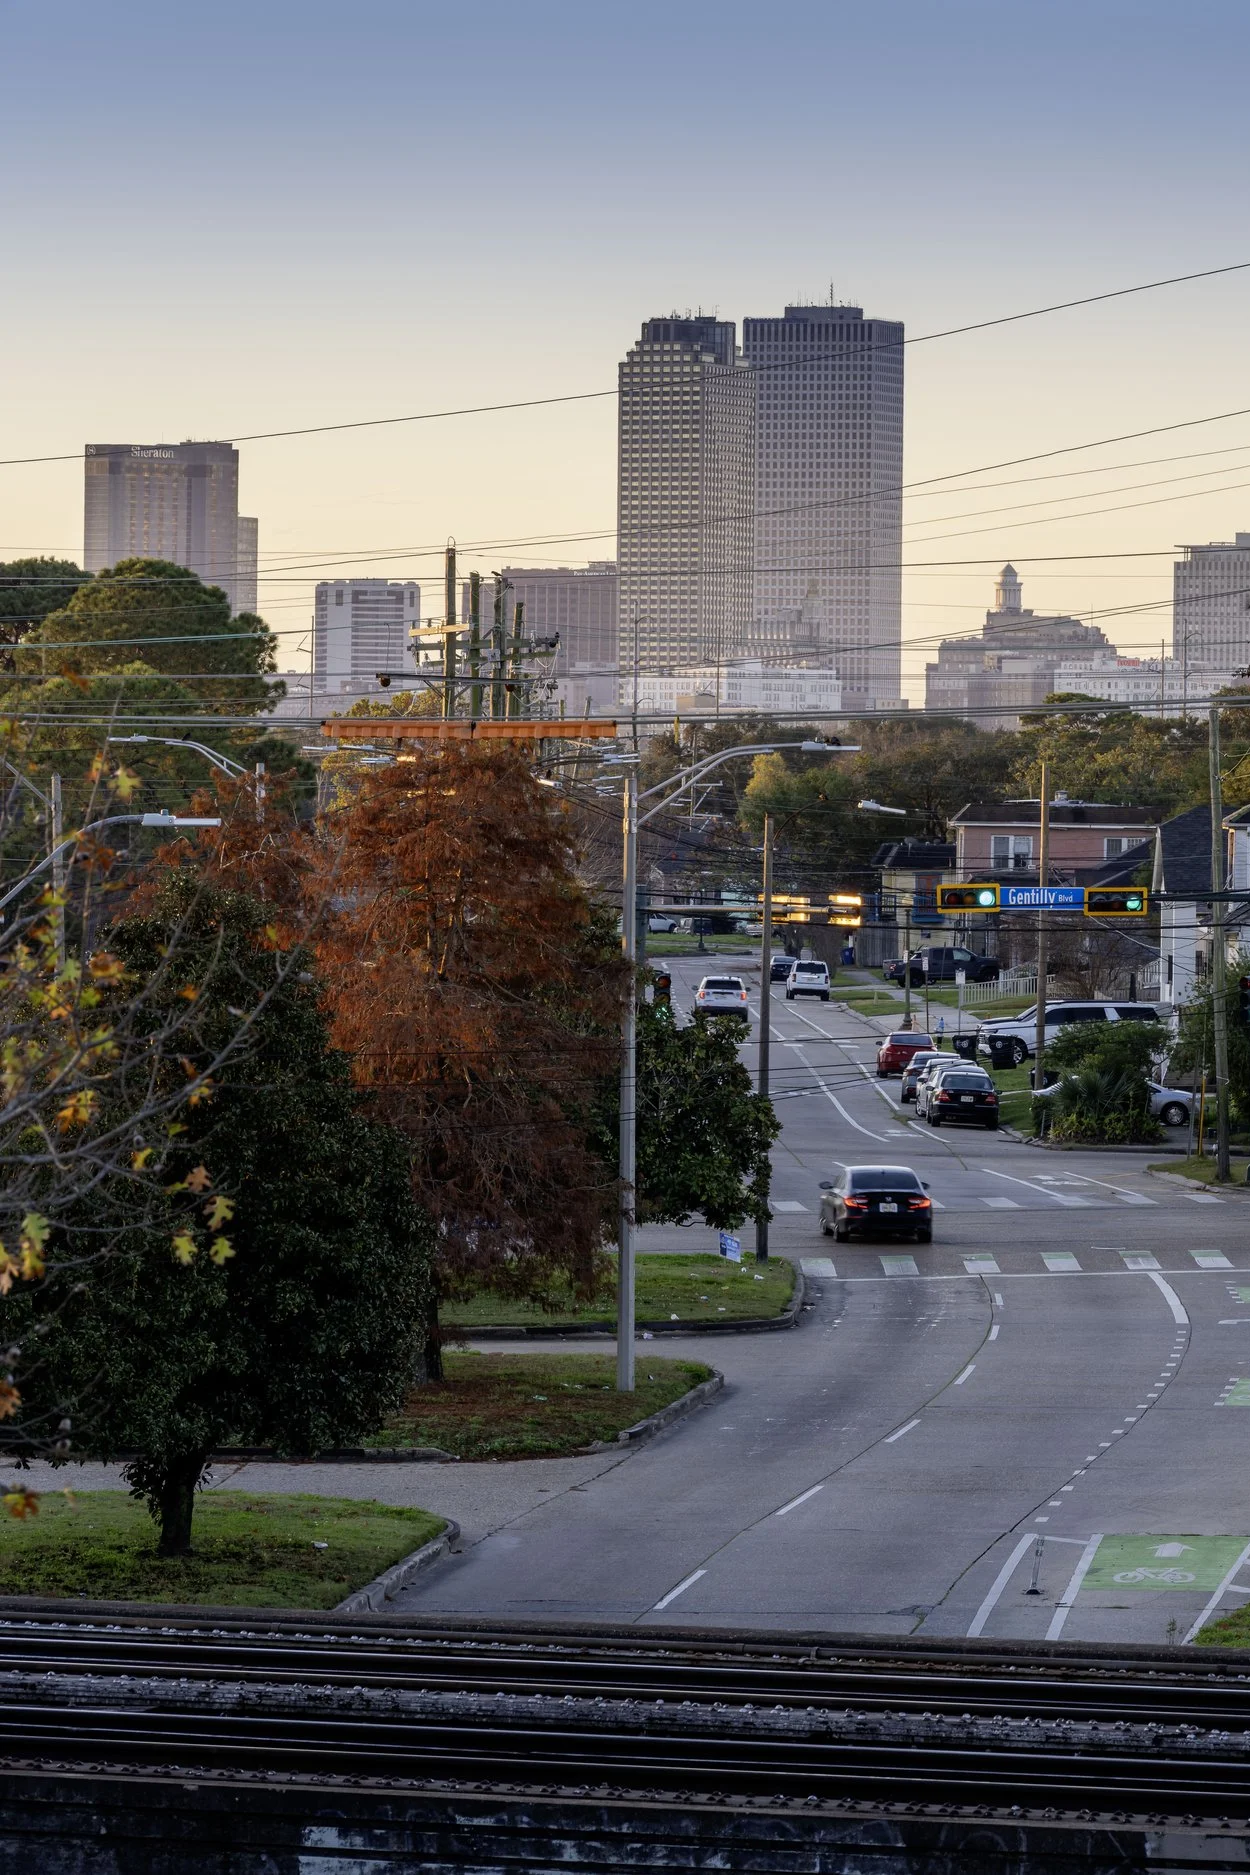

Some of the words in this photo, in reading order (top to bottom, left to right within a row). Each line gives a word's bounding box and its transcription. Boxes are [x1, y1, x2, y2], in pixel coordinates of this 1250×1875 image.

[131, 446, 174, 458] Sheraton
[1009, 889, 1056, 909] Gentilly
[1058, 894, 1073, 902] Blvd
